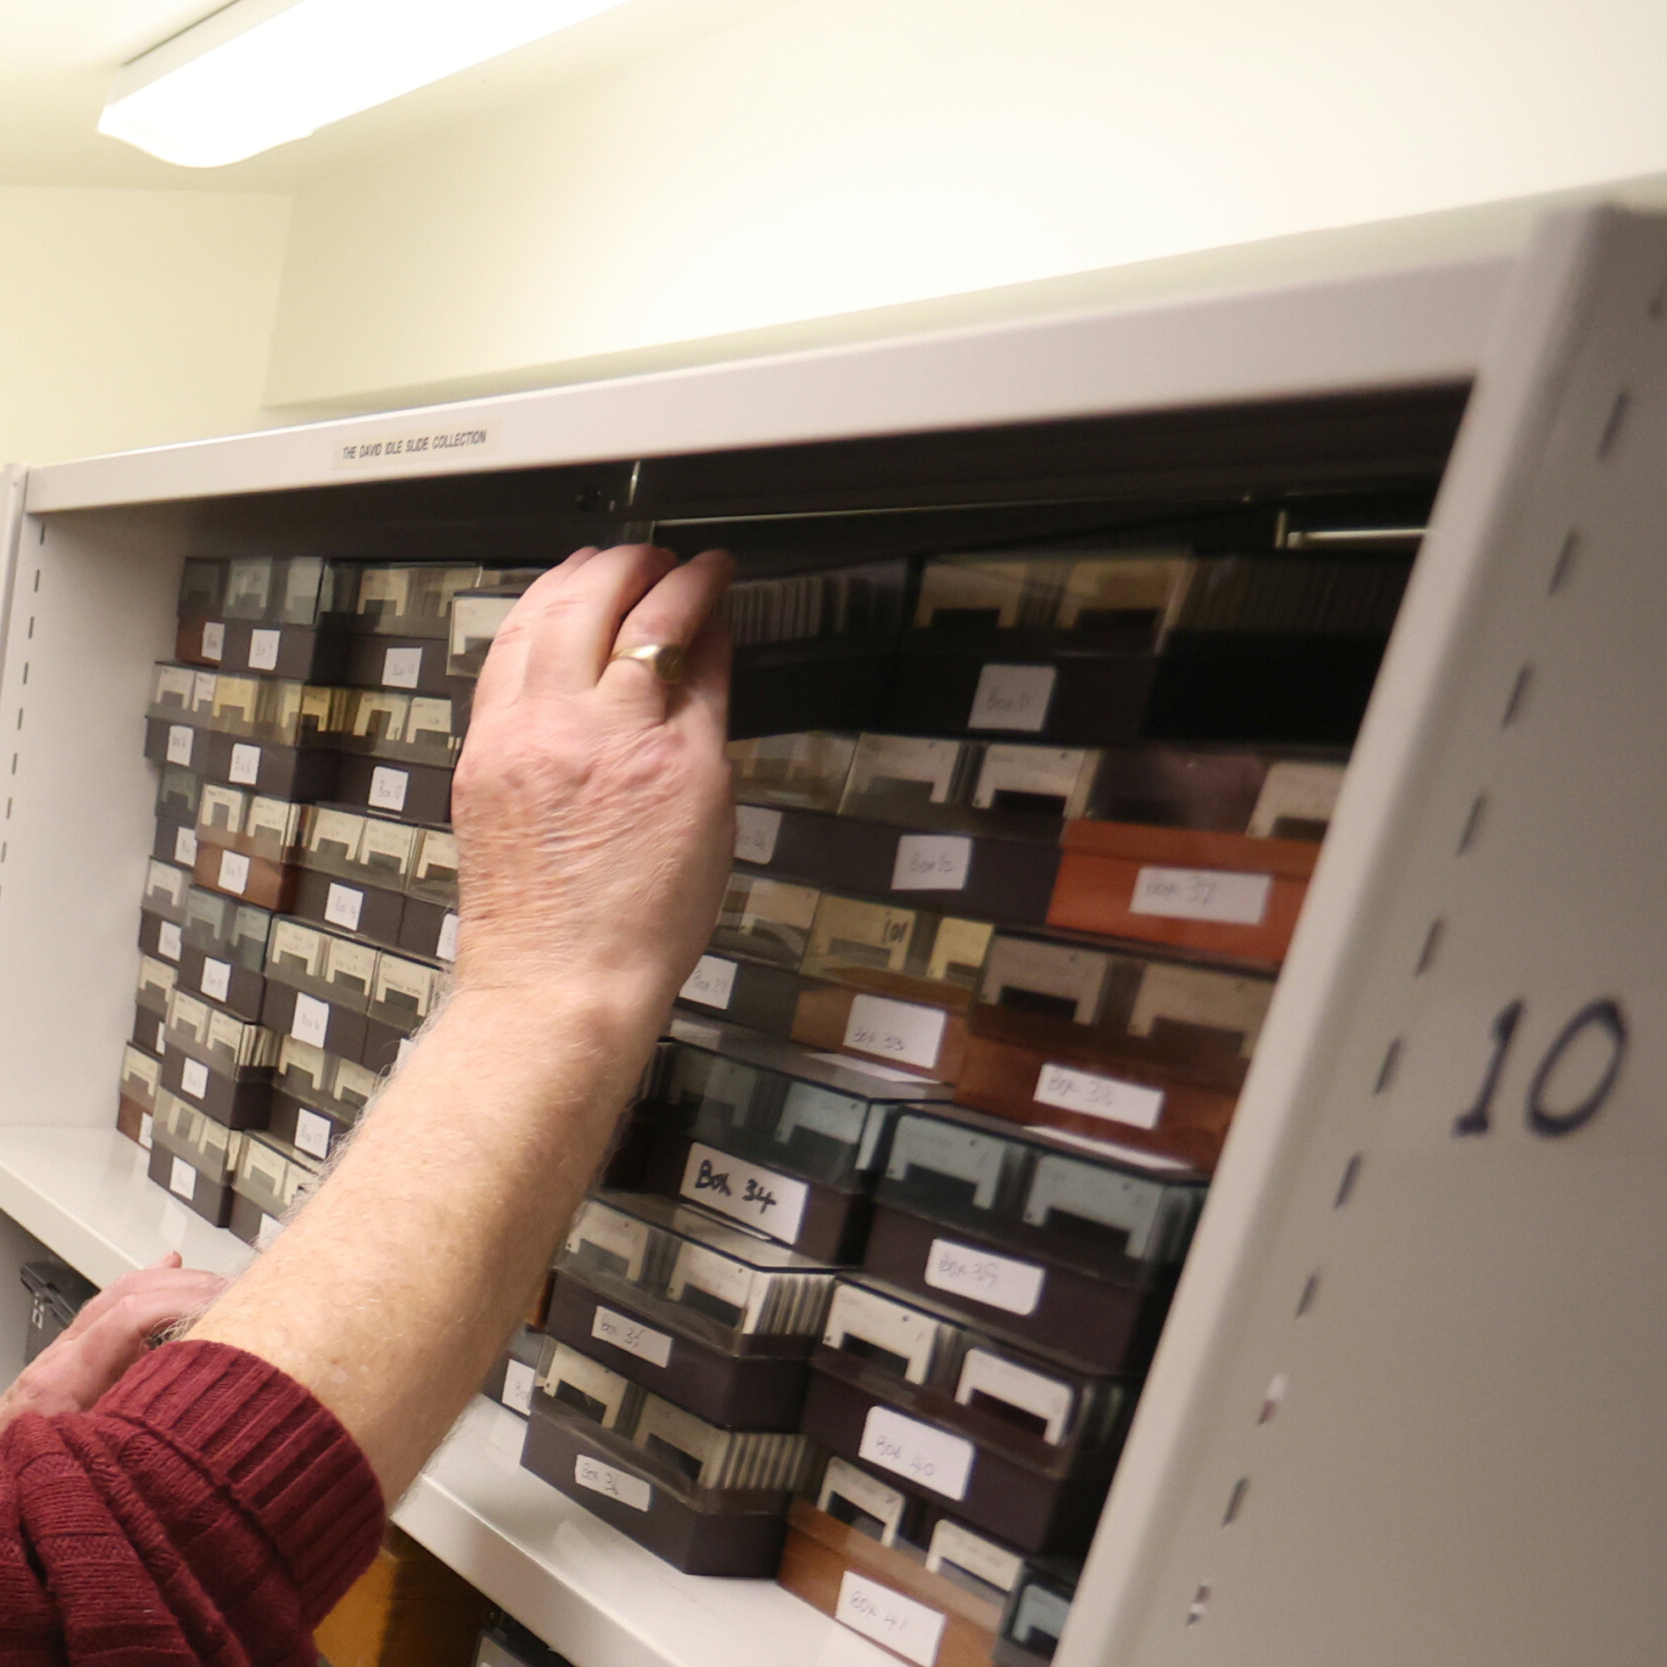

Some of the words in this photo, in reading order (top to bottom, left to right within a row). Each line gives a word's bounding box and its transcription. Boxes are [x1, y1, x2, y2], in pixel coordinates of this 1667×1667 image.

[342, 446, 356, 459] THE
[405, 437, 429, 453] SLIDE
[432, 430, 488, 450] COLLECTION
[1453, 995, 1630, 1139] 10
[694, 1159, 732, 1197] Box
[742, 1178, 777, 1214] 34
